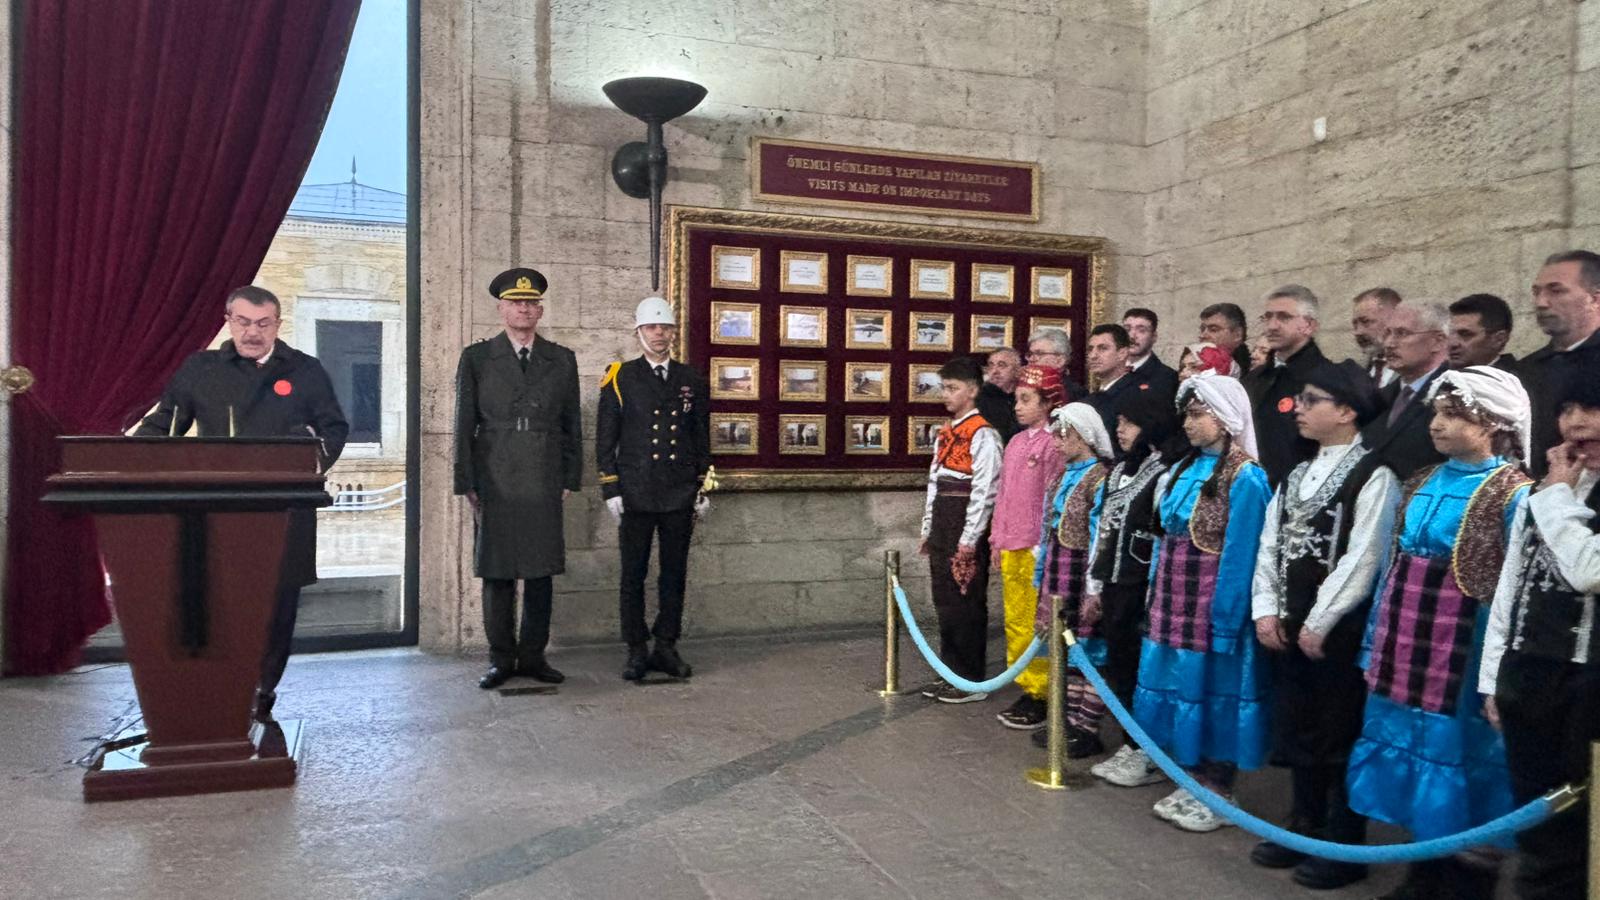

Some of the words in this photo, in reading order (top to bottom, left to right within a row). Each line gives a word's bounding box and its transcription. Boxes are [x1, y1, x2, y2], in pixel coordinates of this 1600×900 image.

[808, 178, 846, 191] VISITS
[848, 181, 880, 194] MADE
[882, 184, 897, 196] ON
[899, 186, 962, 201] IMPORTANT
[963, 191, 991, 203] DAYS
